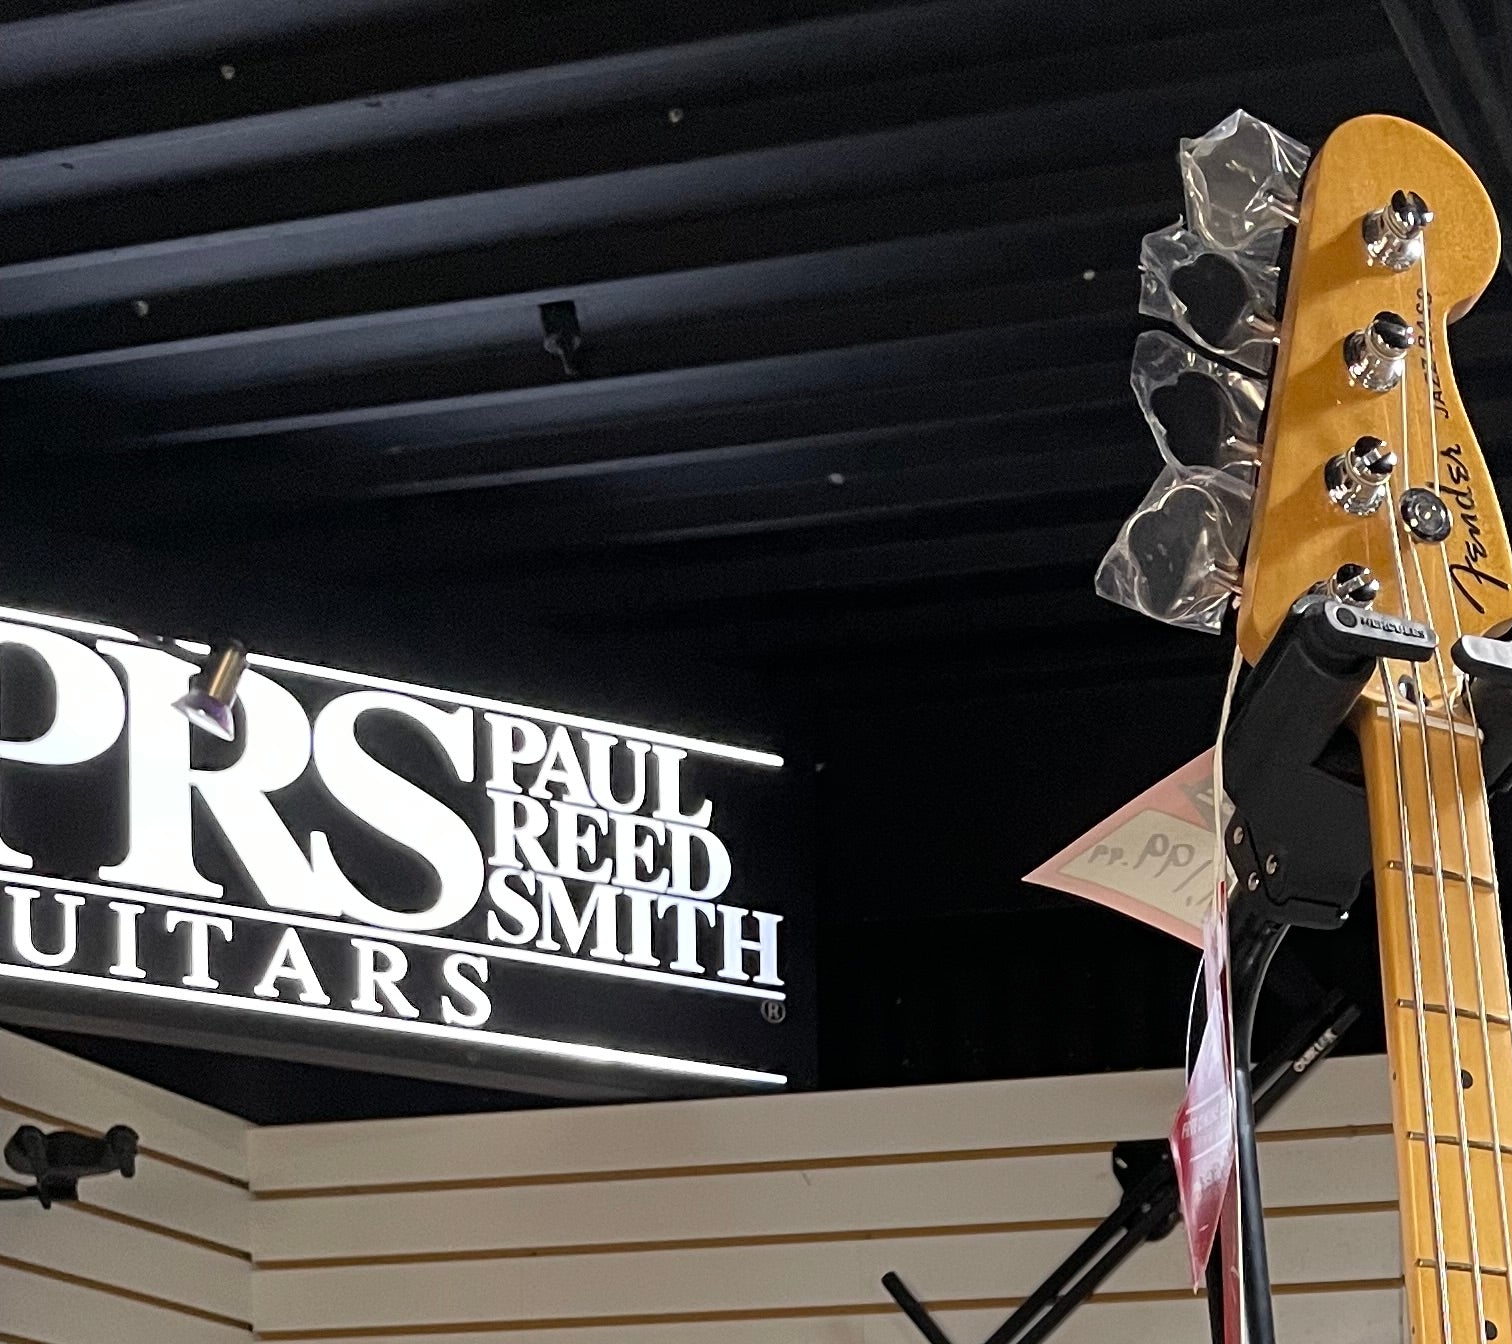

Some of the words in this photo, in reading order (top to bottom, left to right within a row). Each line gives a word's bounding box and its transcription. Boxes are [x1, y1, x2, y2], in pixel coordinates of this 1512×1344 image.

[1426, 443, 1511, 614] Fender
[0, 620, 484, 931] PRS
[485, 711, 713, 829] PAUL
[487, 789, 732, 901] REED
[5, 885, 493, 1028] UITARS
[487, 864, 784, 986] SMITH
